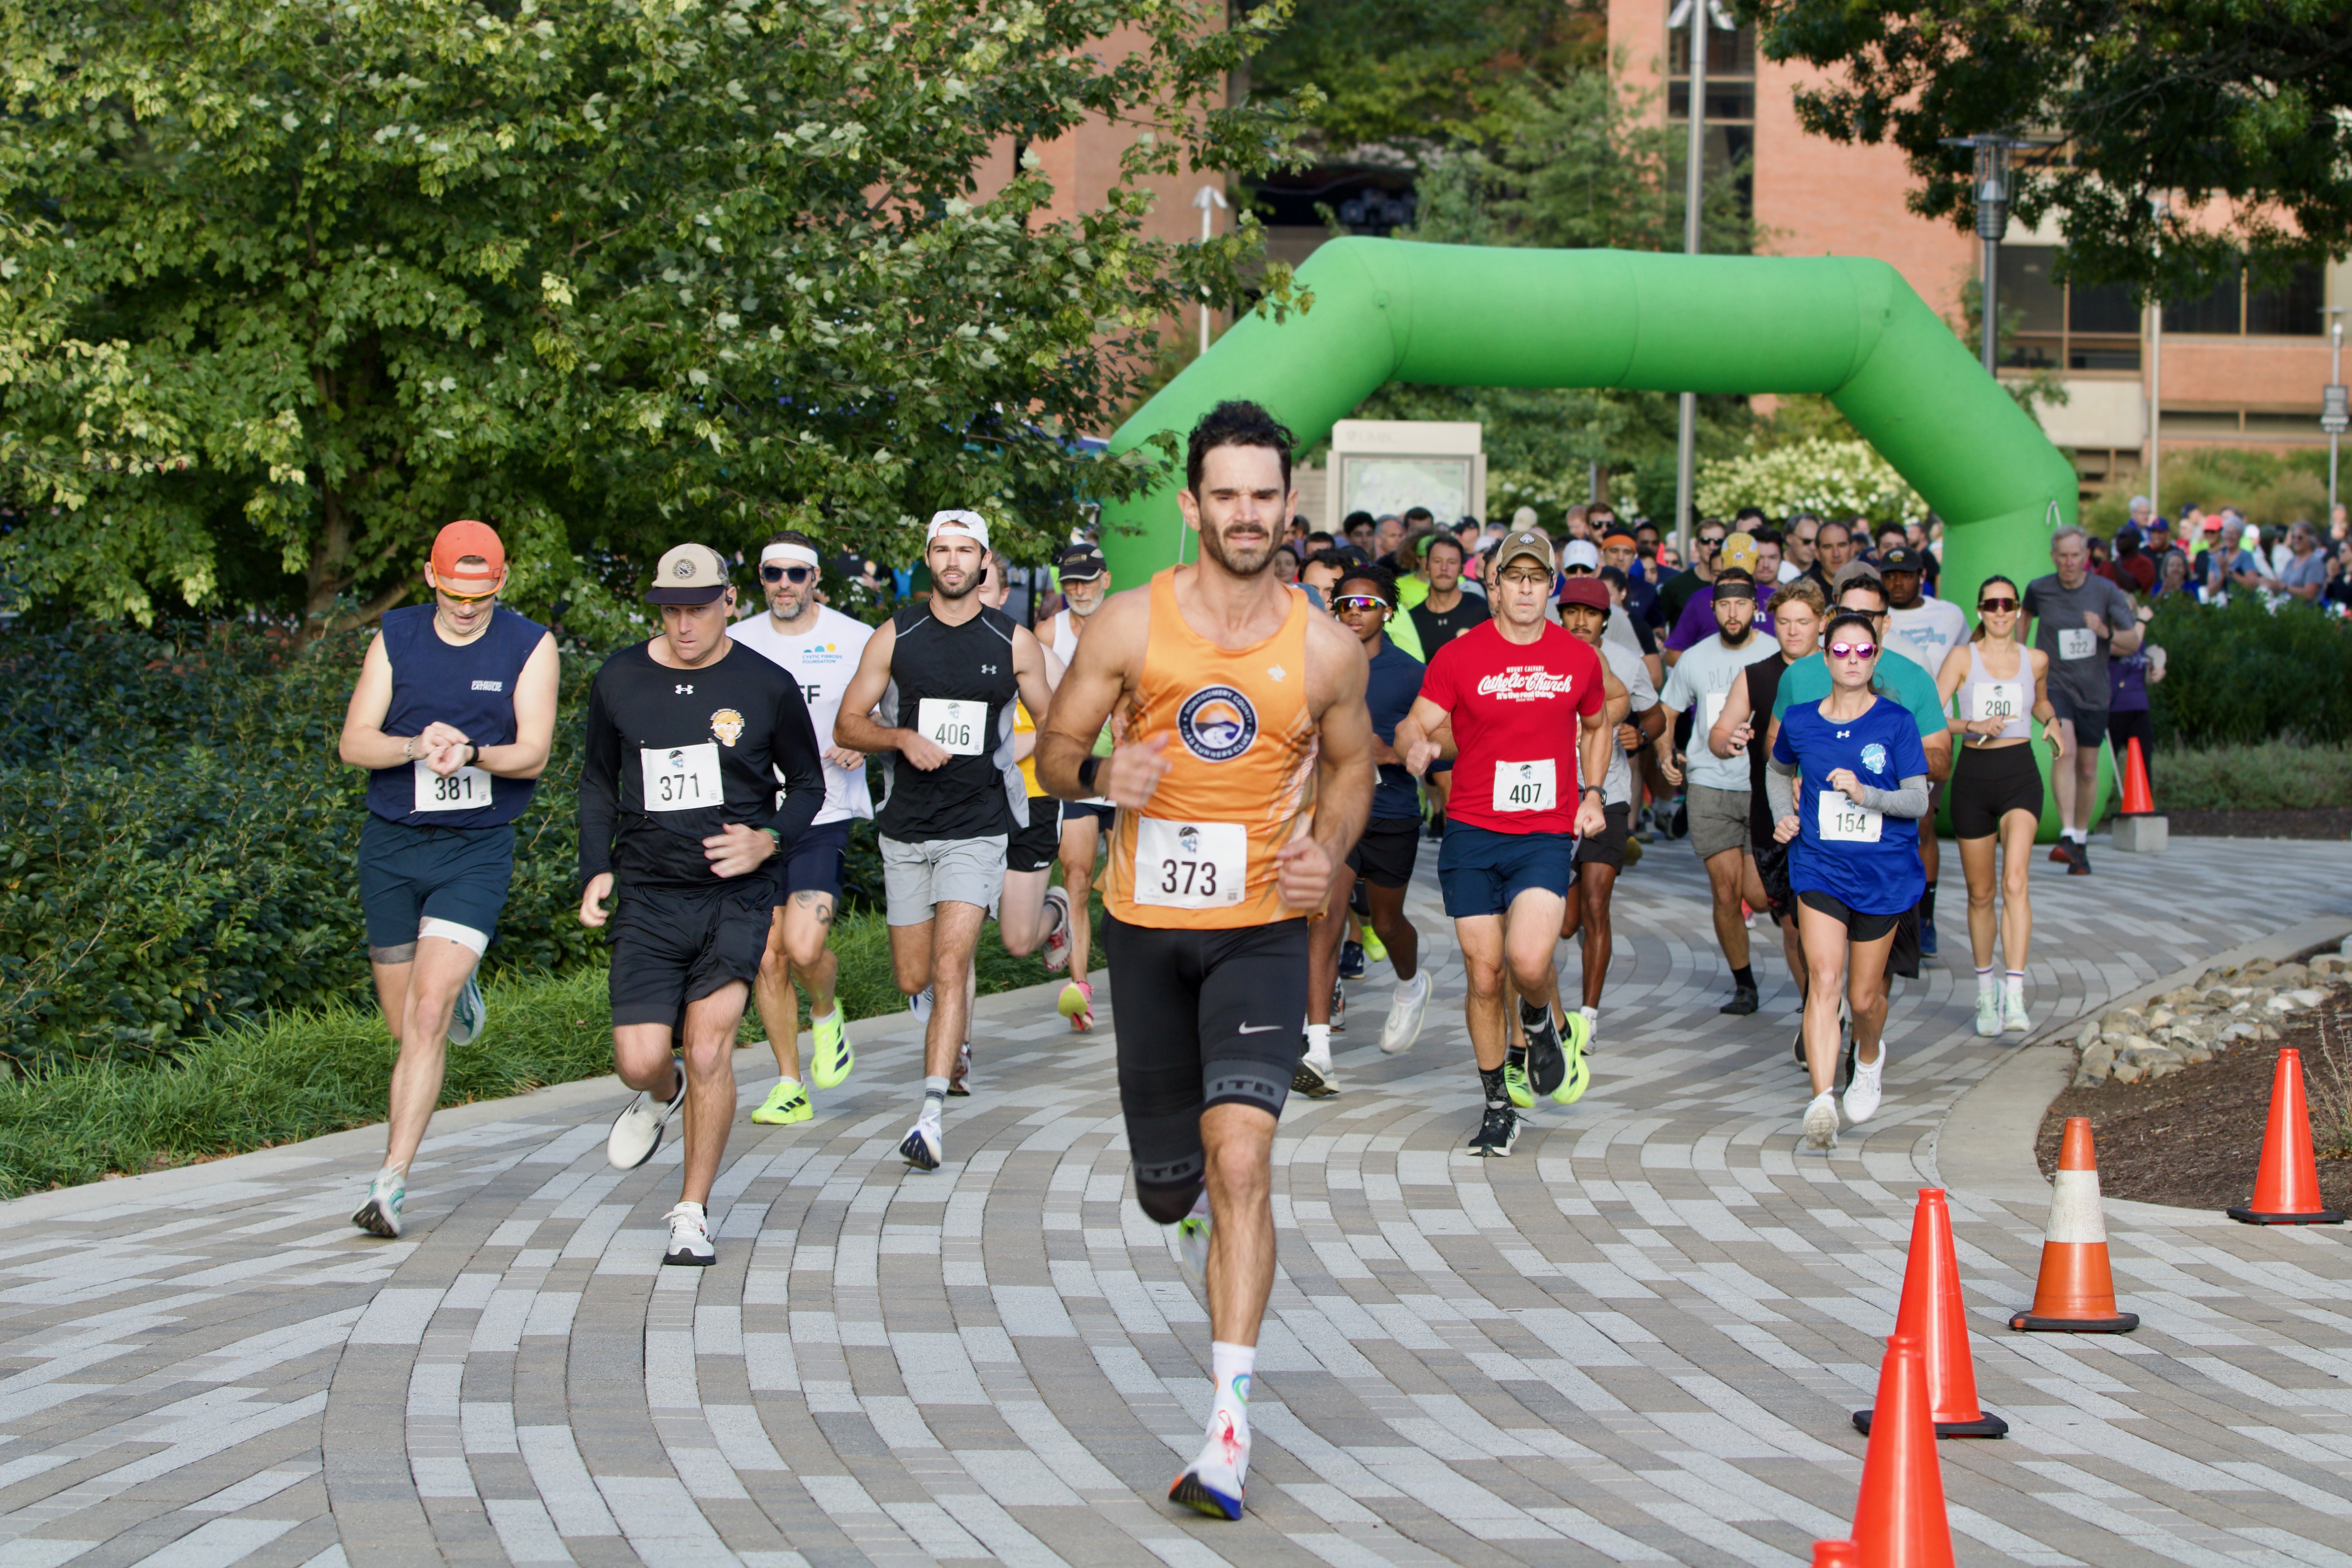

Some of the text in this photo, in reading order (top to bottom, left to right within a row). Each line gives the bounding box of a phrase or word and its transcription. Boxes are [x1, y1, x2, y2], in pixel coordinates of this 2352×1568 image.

[2069, 641, 2089, 654] 322
[471, 683, 502, 692] CATHOLIC
[1477, 672, 1572, 695] Catholic Church
[1184, 690, 1253, 724] MONTGOMERY COUNTY
[1985, 701, 2011, 716] 280
[935, 723, 970, 746] 406
[1193, 743, 1233, 759] RUNNERS
[1233, 733, 1251, 753] CLUB
[435, 776, 472, 800] 381
[660, 773, 699, 801] 371
[1509, 783, 1541, 804] 407
[1836, 813, 1866, 833] 154
[1161, 859, 1216, 897] 373
[1217, 1080, 1274, 1096] ITB
